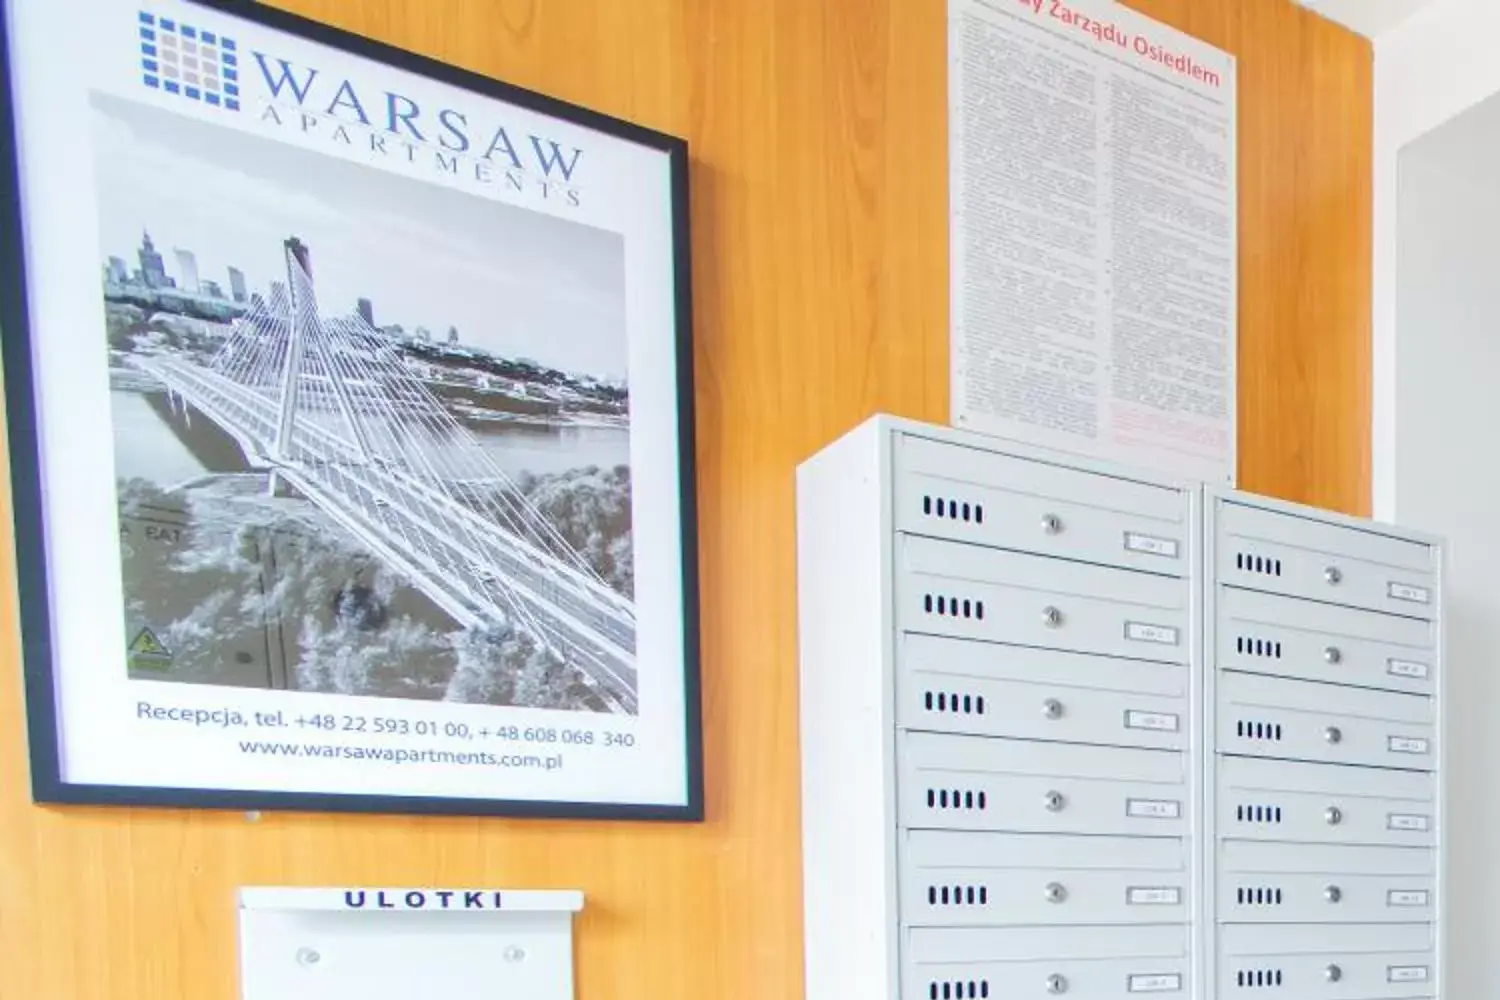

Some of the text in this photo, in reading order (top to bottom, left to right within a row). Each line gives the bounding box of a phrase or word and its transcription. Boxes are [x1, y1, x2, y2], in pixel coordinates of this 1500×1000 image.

[1132, 36, 1221, 88] Osiedlem
[250, 49, 585, 183] WARSAW
[260, 103, 582, 208] APARTMENTS
[136, 700, 248, 728] Recepcja,
[254, 710, 289, 728] tel.
[294, 713, 336, 732] +48
[341, 715, 368, 733] 22
[373, 717, 410, 735] 593
[415, 720, 438, 736] 01
[444, 721, 474, 741] 00,
[495, 725, 519, 741] 48
[523, 726, 557, 743] 608
[561, 728, 595, 746] 068
[602, 730, 636, 748] 340
[238, 740, 564, 771] www.warsawapartments.com.pl
[344, 890, 502, 909] ULOTKI
